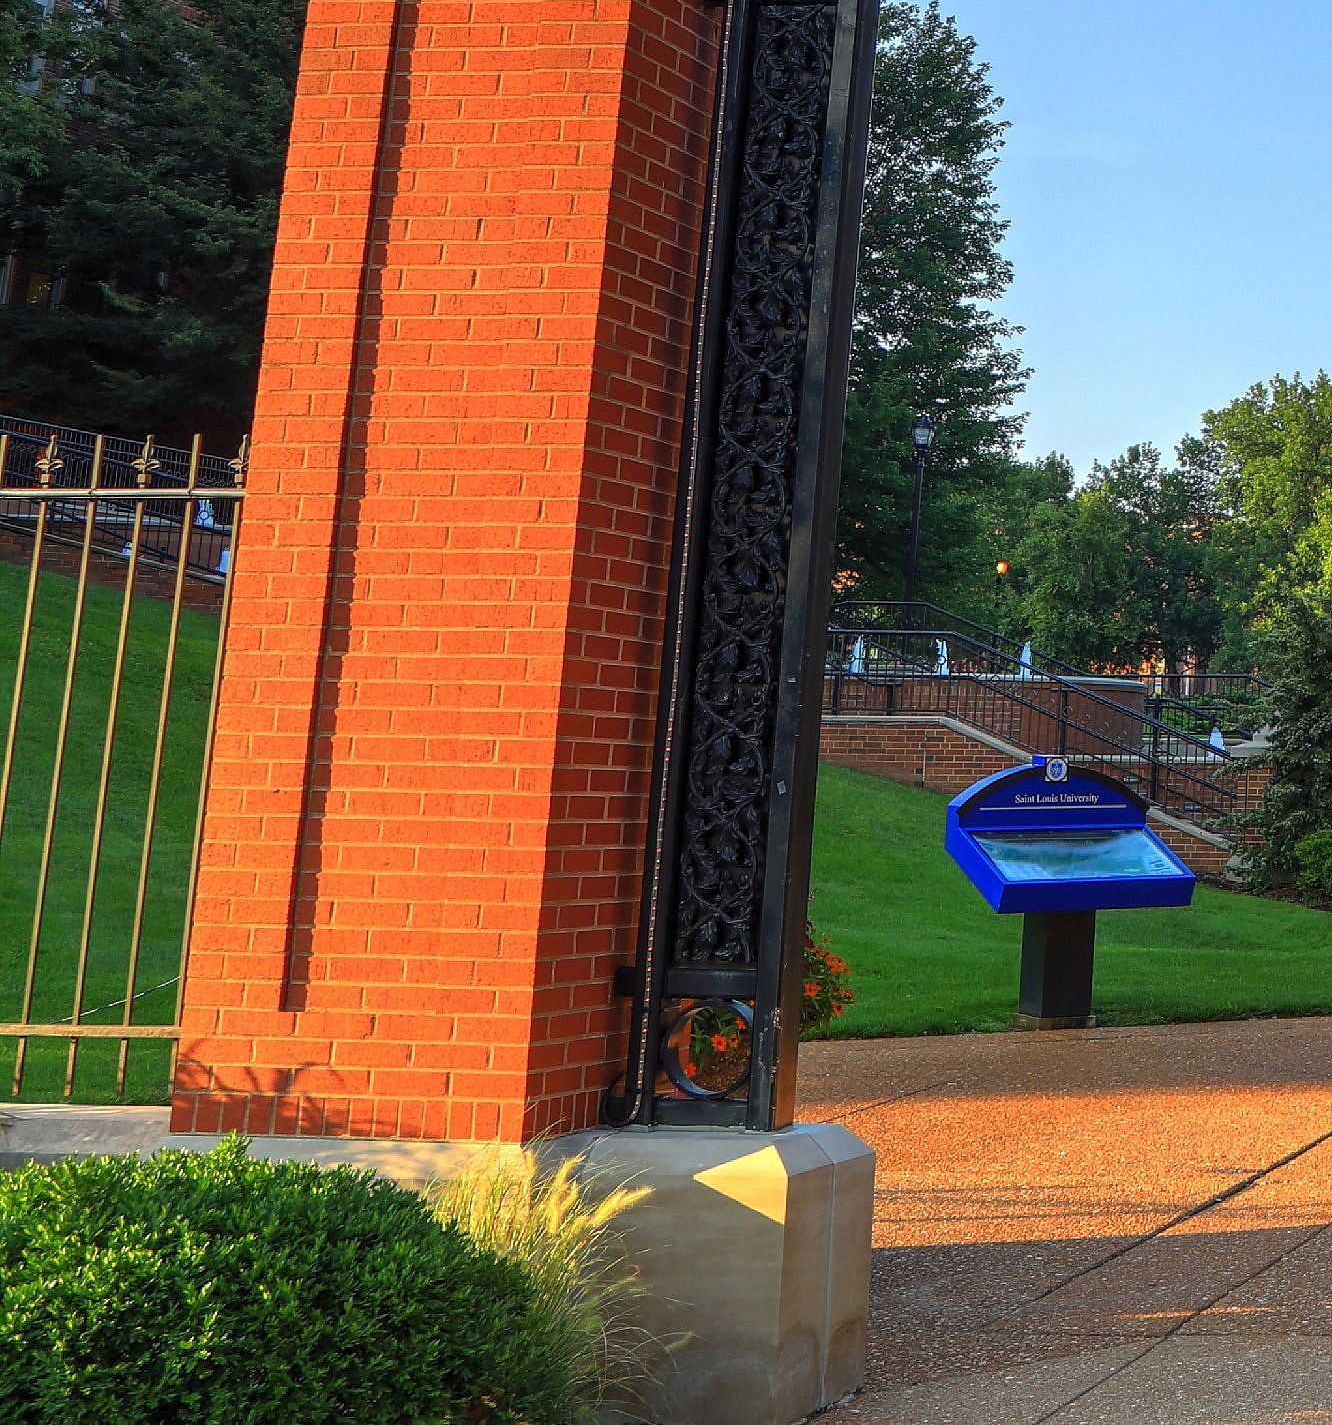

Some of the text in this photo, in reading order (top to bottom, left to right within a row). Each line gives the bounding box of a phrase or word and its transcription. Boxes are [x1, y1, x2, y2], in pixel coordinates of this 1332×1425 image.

[1014, 792, 1100, 805] Saint Louis University
